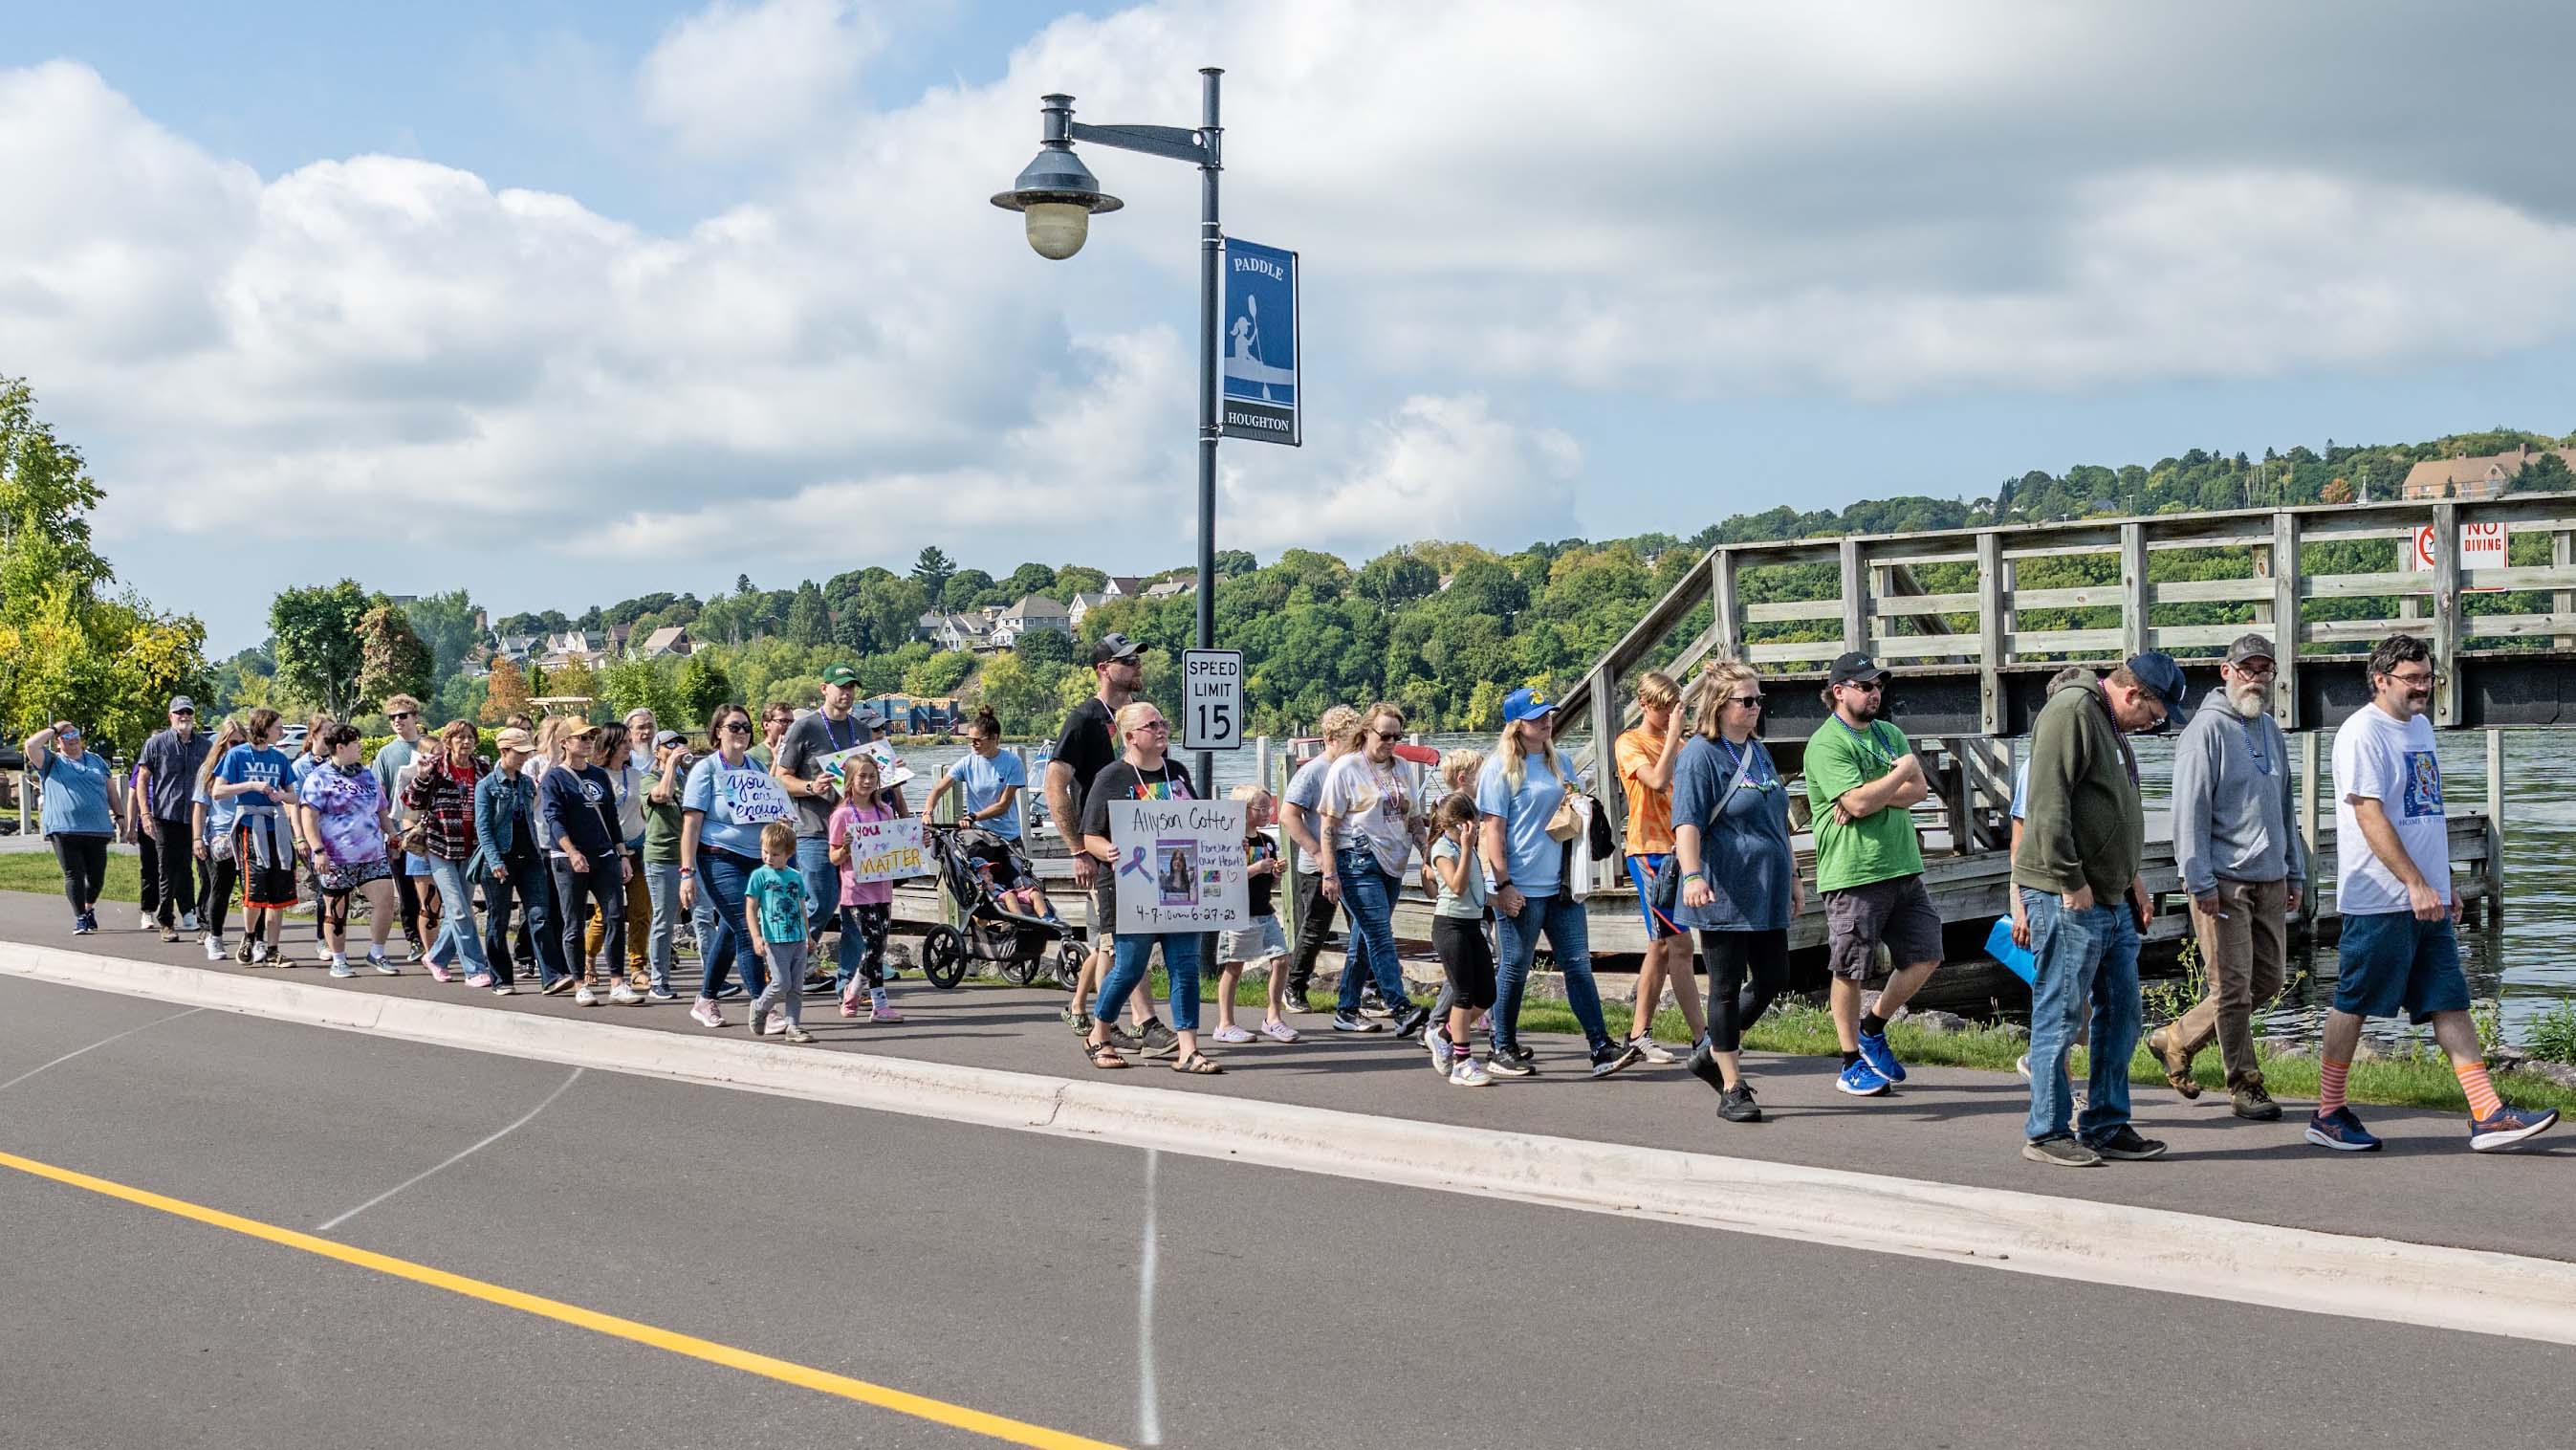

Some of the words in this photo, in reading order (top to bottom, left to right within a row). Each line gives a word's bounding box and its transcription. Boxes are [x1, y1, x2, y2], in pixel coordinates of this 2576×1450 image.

[1233, 257, 1284, 281] PADDLE
[1228, 411, 1289, 430] HOUGHTON
[2468, 521, 2498, 536] NO
[2464, 538, 2501, 552] DIVING
[1190, 661, 1237, 675] SPEED
[1194, 683, 1232, 696] LIMIT
[1198, 704, 1231, 740] 15
[1132, 807, 1183, 838] Allyson
[1189, 807, 1236, 831] Cotter
[860, 847, 921, 873] MATTER
